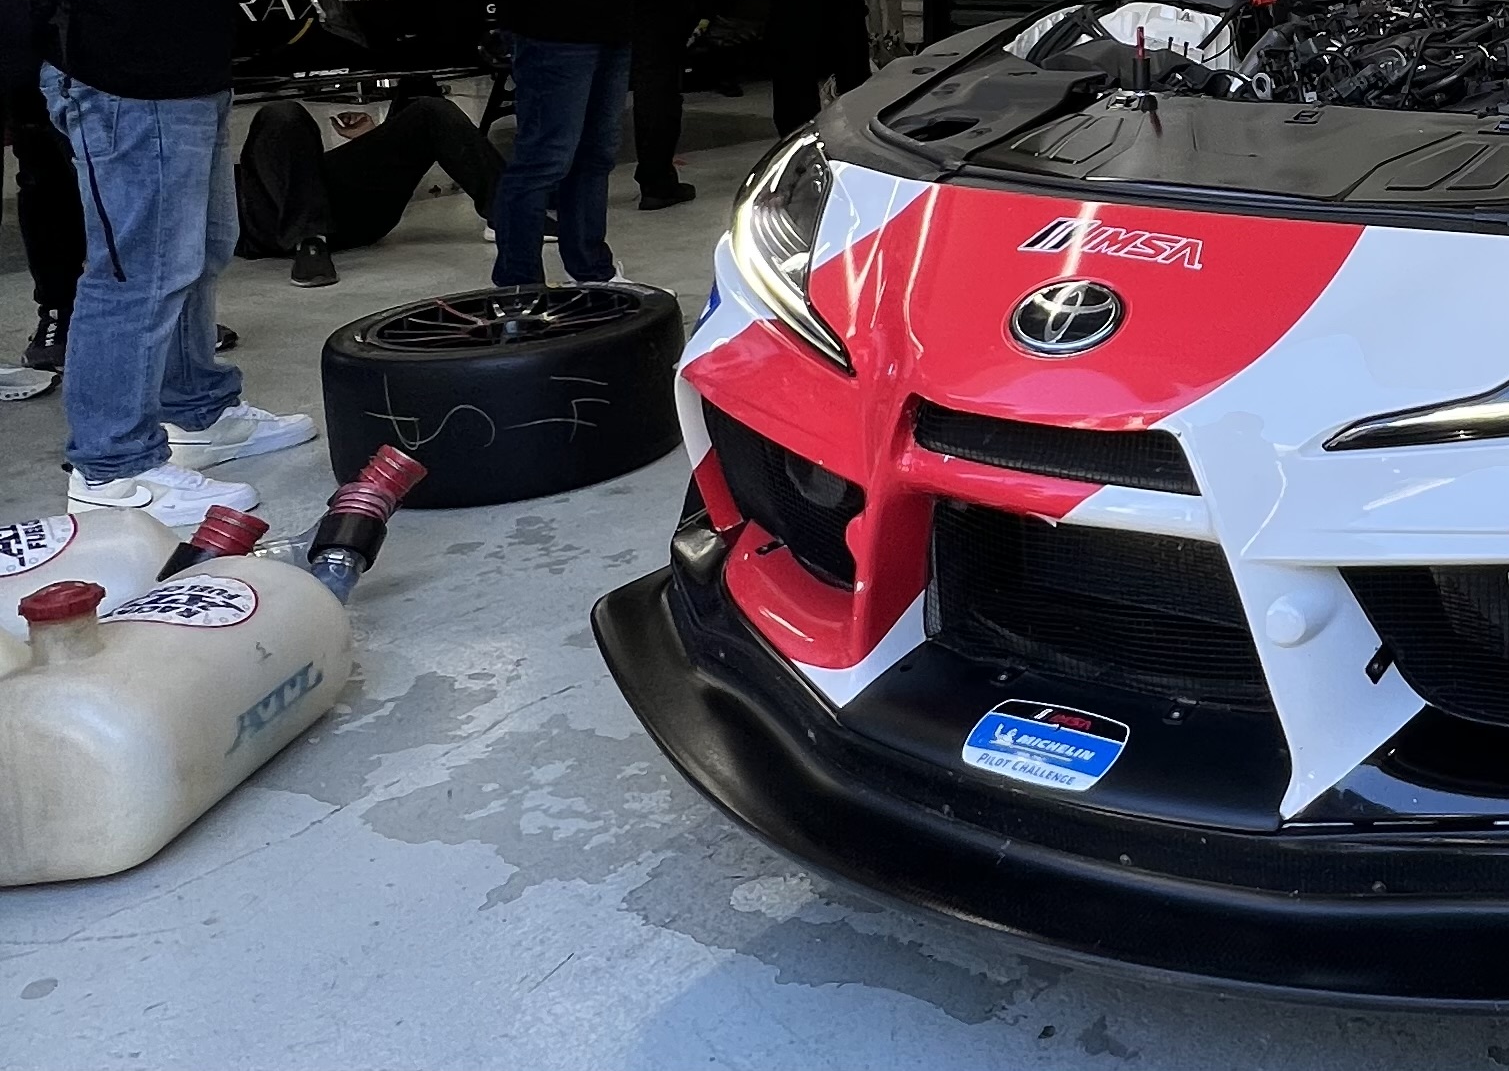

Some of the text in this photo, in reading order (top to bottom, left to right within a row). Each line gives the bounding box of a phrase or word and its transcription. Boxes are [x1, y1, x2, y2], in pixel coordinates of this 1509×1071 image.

[1072, 221, 1203, 270] IMSA
[1015, 734, 1096, 761] MICHELIN
[976, 752, 1077, 786] PILOT CHALLENGE
